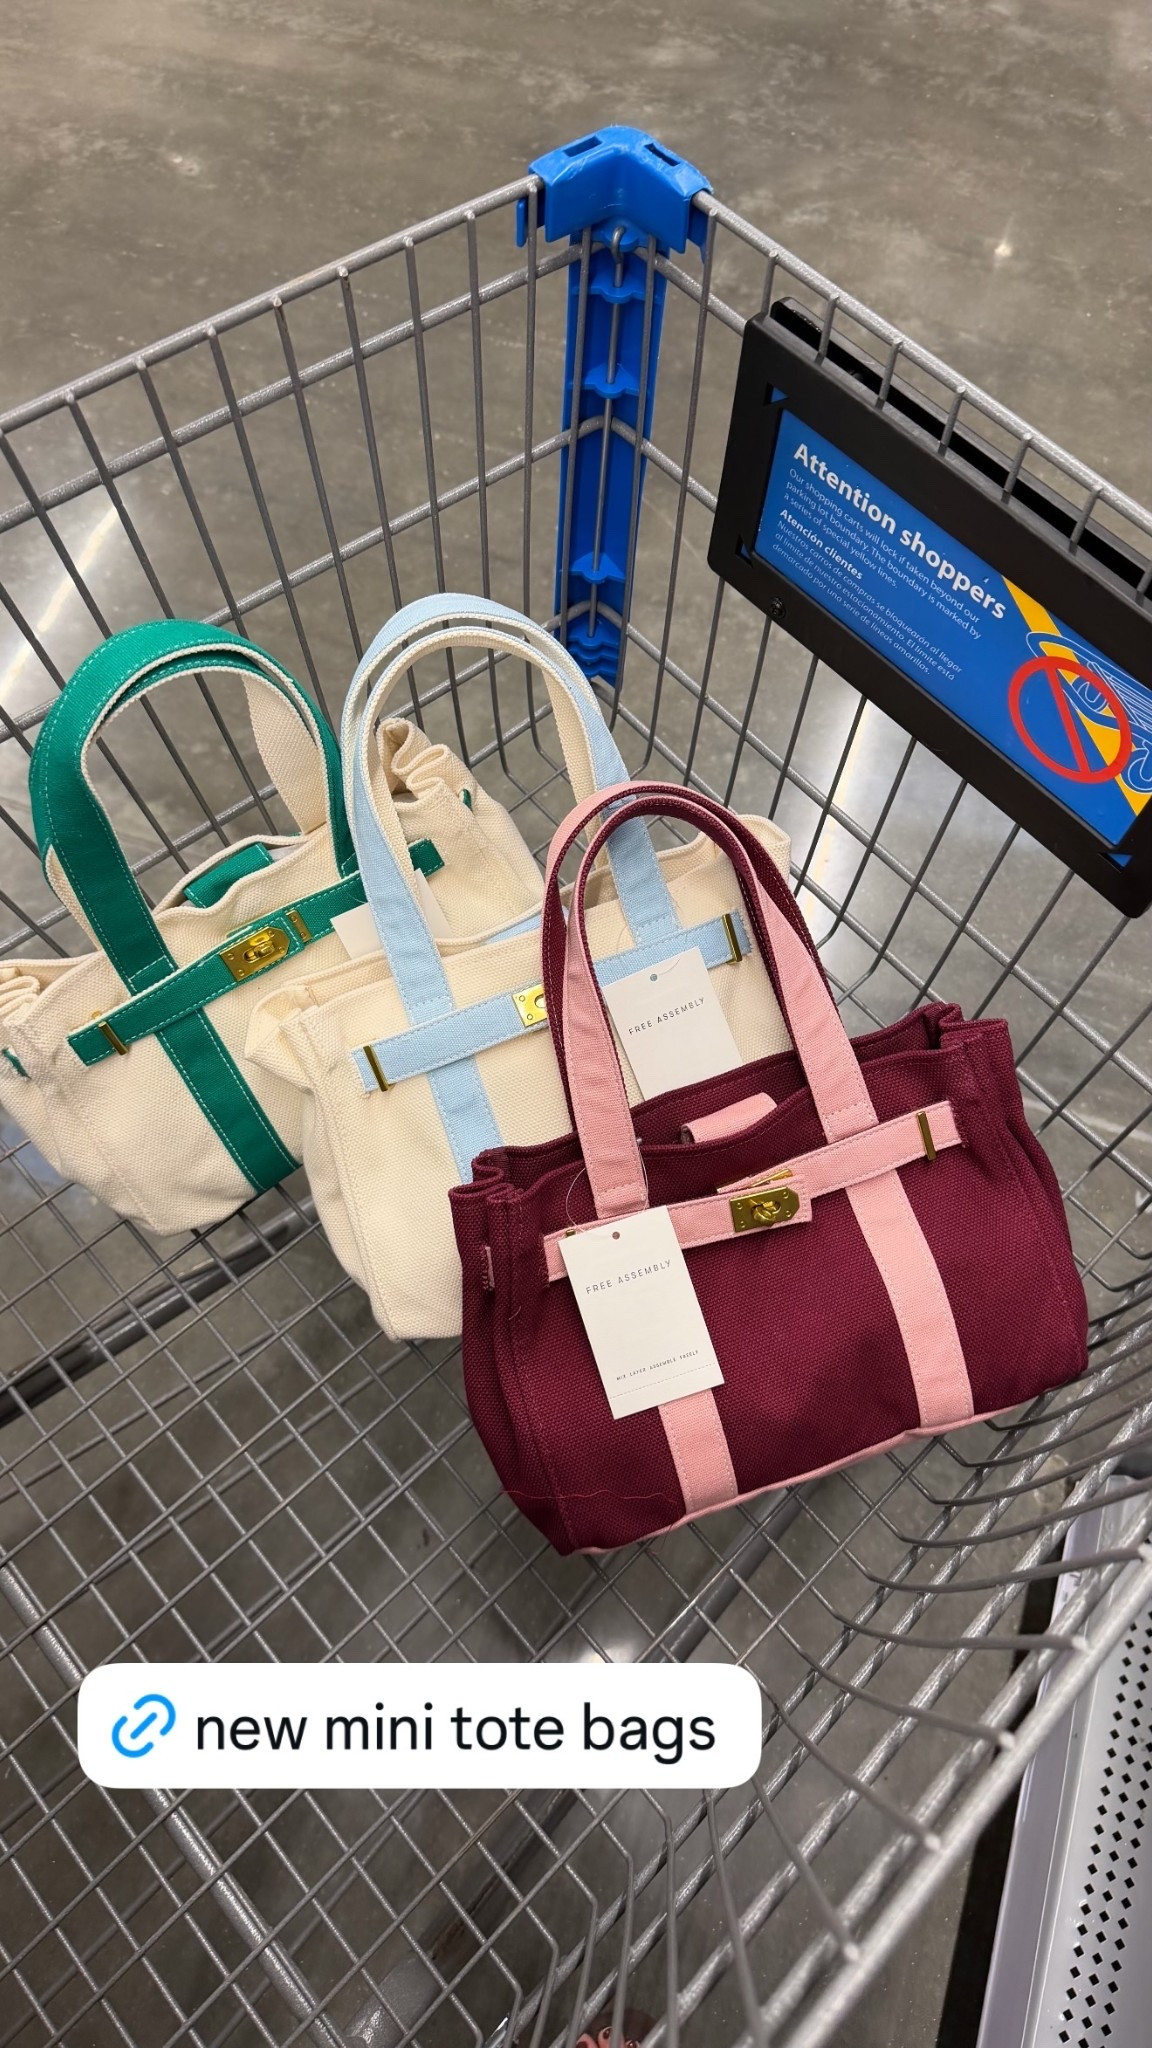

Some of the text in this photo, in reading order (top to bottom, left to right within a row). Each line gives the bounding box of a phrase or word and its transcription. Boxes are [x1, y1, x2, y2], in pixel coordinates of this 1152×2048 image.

[780, 509, 863, 579] Atención clientes
[786, 481, 817, 510] parking
[817, 504, 829, 518] lot
[871, 546, 886, 564] The
[887, 560, 928, 597] boundary
[936, 601, 969, 630] marked
[969, 626, 981, 640] by
[789, 468, 805, 485] Our
[805, 482, 843, 517] shopping
[844, 513, 863, 532] carts
[865, 529, 880, 544] will
[880, 540, 898, 559] lock
[906, 561, 929, 584] taken
[930, 580, 964, 611] beyond
[964, 609, 980, 623] our
[790, 498, 812, 519] series
[822, 524, 850, 549] special
[850, 546, 877, 570] yellow
[793, 443, 1006, 619] Attention shoppers
[772, 544, 813, 579] demarcado
[812, 577, 827, 589] por
[843, 600, 860, 617] serie
[777, 520, 809, 550] Nuestros
[809, 548, 832, 569] carros
[843, 576, 875, 604] compras
[885, 608, 930, 648] bloquearán
[938, 651, 962, 673] llegar
[814, 565, 842, 589] nuestro
[628, 996, 705, 1035] FREE ASSEMBLY
[586, 1259, 671, 1295] FREE ASSEMBLY
